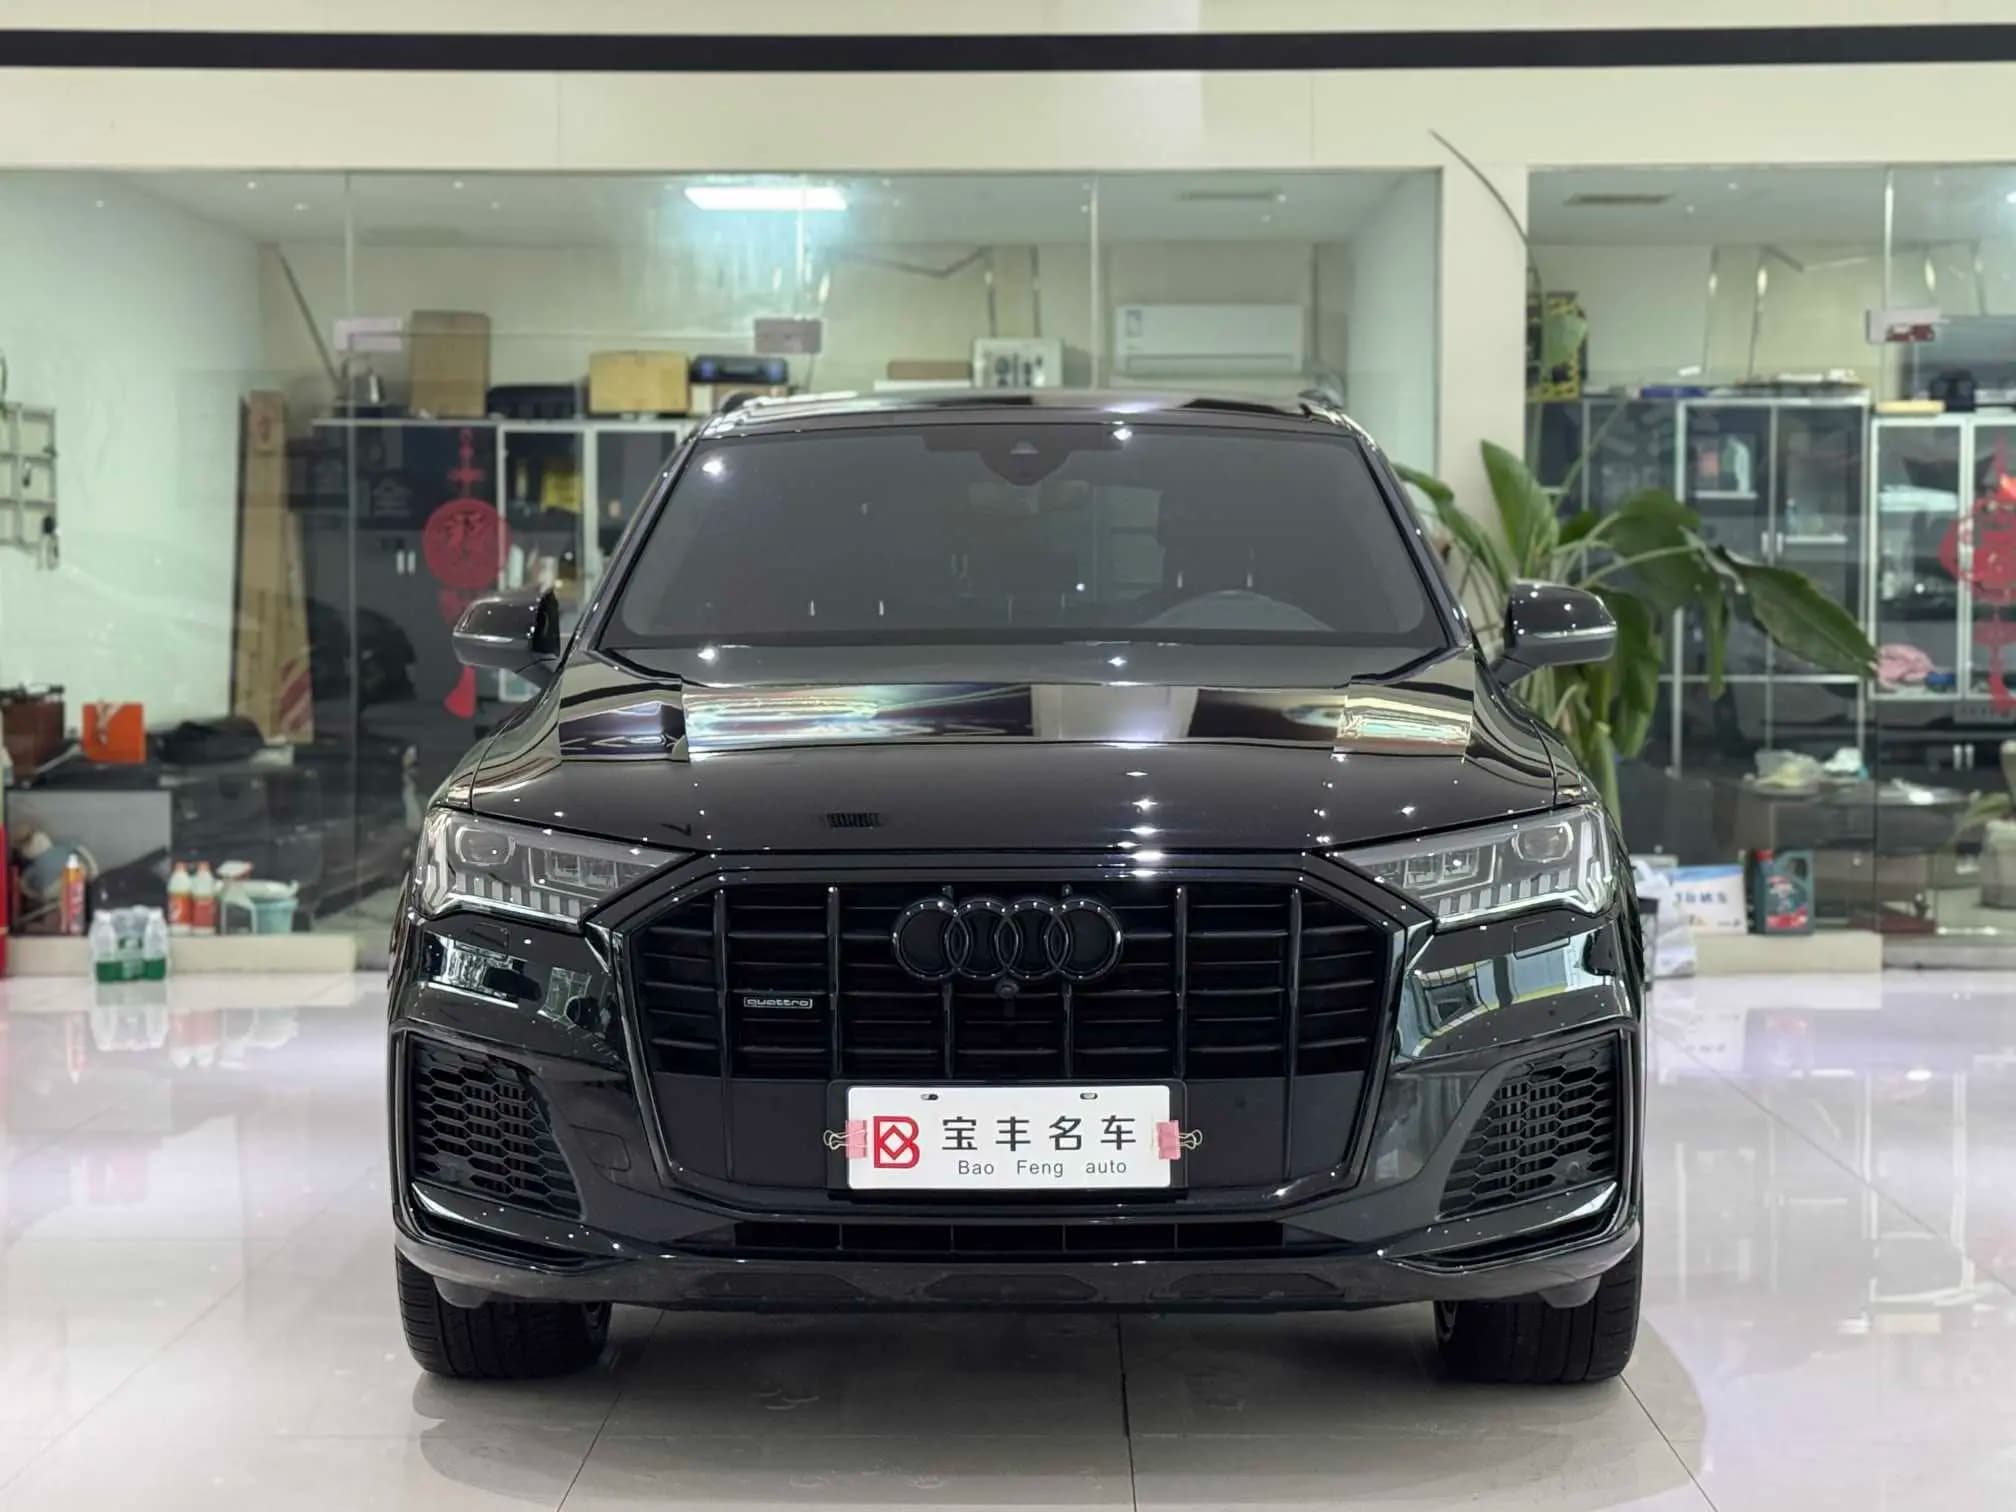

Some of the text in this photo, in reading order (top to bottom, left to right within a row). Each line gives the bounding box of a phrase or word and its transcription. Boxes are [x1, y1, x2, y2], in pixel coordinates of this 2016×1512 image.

[746, 998, 809, 1008] quattro
[941, 1115, 1137, 1152] 宝丰名车
[958, 1160, 1127, 1178] Bao Feng auto
